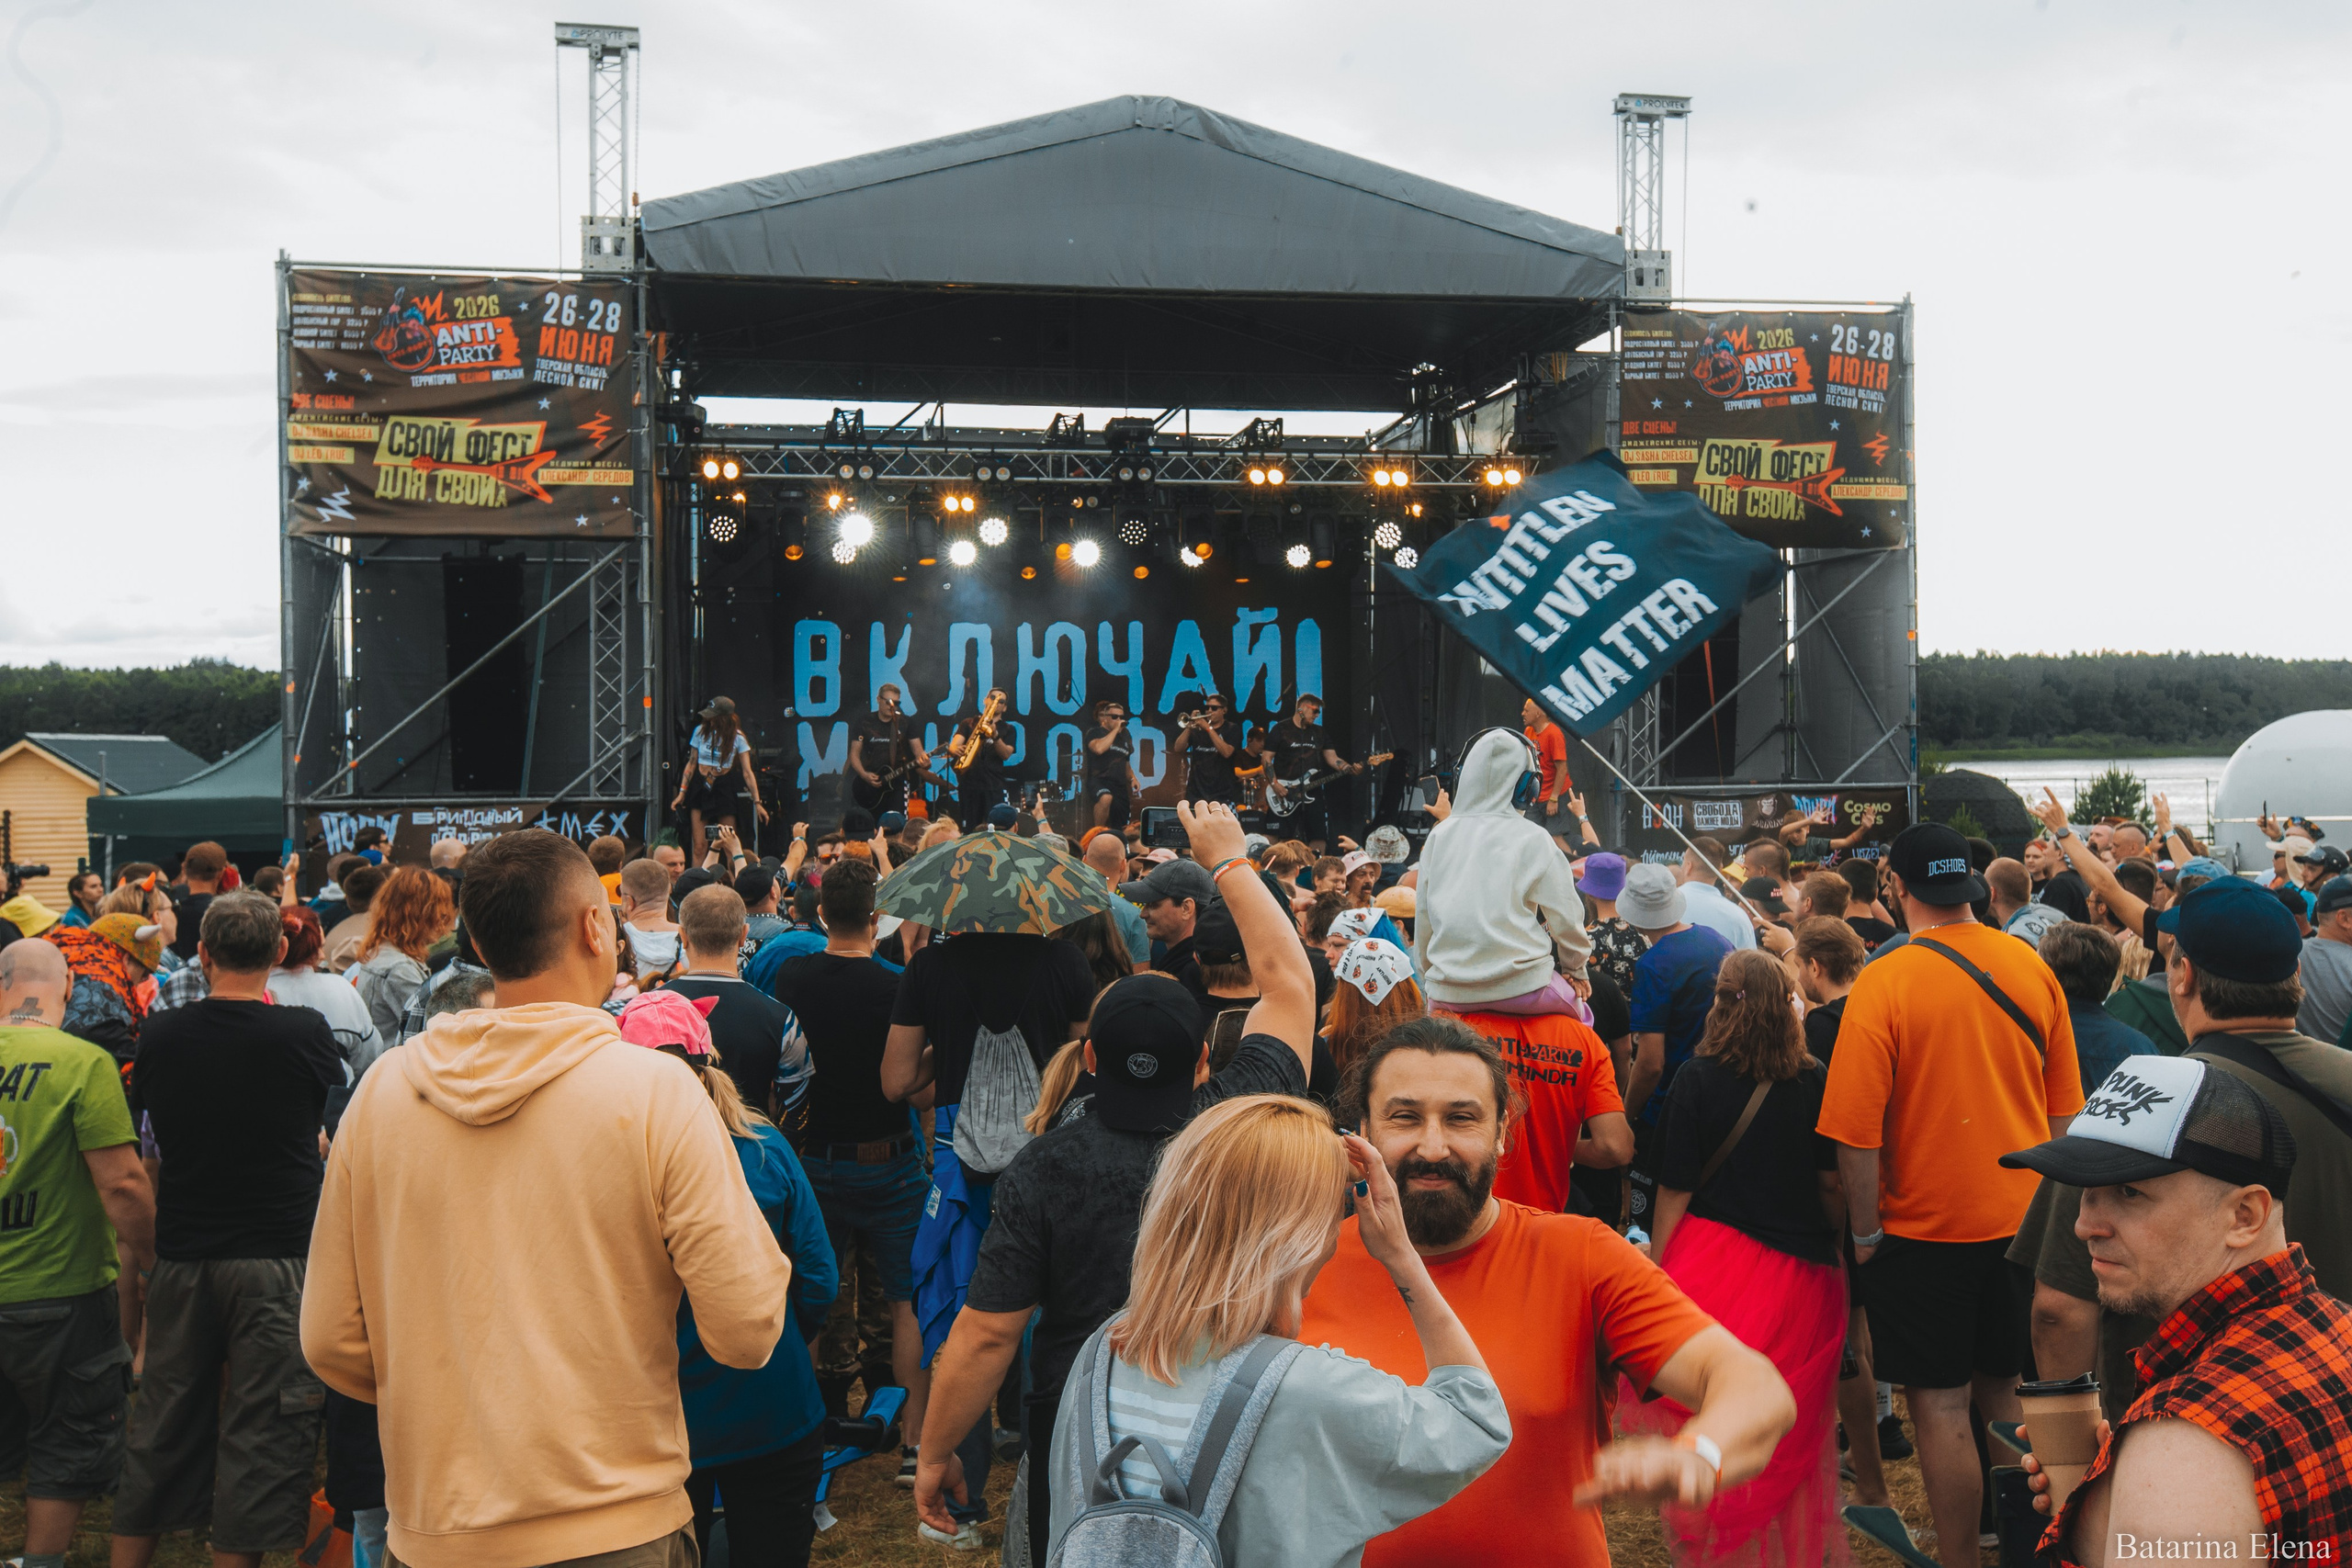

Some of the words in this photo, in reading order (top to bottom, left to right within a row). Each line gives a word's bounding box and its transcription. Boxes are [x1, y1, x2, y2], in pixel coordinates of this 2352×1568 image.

[1643, 98, 1680, 108] PROLYTE
[454, 294, 501, 320] 2026
[542, 291, 622, 333] 26-28
[436, 321, 503, 347] ANTI-
[1757, 328, 1795, 350] 2026
[1830, 324, 1895, 361] 26-28
[438, 344, 496, 367] PARTY
[538, 325, 615, 366] ИЮНЯ
[536, 358, 572, 373] ТВЕРСКАЯ
[1745, 352, 1798, 375] ANTI-
[1827, 354, 1889, 391] ИЮНЯ
[410, 373, 458, 388] ТЕРРИТОРИЯ
[491, 367, 525, 381] МУЗЫКИ
[533, 369, 574, 387] ЛЕСНОЙ
[578, 376, 606, 391] СКИТ
[1746, 371, 1792, 391] PARTY
[1826, 383, 1856, 397] ТВЕРСКАЯ
[1724, 398, 1762, 412] ТЕРРИТОРИЯ
[1790, 392, 1817, 405] МУЗЫКИ
[1825, 394, 1858, 410] ЛЕСНОЙ
[1861, 400, 1883, 413] СКИТ
[292, 425, 304, 437] DJ
[335, 427, 373, 440] CHELSEA
[1623, 421, 1641, 435] ДВЕ
[1643, 421, 1677, 434] СЦЕНЫ!
[388, 421, 457, 461] СВОЙ
[466, 429, 533, 465] ФЕСТ
[294, 447, 305, 460] DJ
[307, 448, 322, 460] LEO
[325, 449, 346, 461] TRUE
[1623, 450, 1634, 462] DJ
[1635, 450, 1660, 461] SASHA
[1661, 450, 1693, 461] CHELSEA
[1705, 443, 1762, 479] СВОЙ
[1770, 449, 1826, 480] ФЕСТ
[375, 465, 428, 502] ДЛЯ
[540, 470, 590, 483] АЛЕКСАНДР
[593, 470, 633, 484] СЕРЕДОВ!
[1637, 470, 1650, 482] LEO
[1653, 470, 1671, 482] TRUE
[1832, 485, 1872, 497] АЛЕКСАНДР
[1514, 540, 1637, 653] LIVES
[1540, 578, 1719, 722] MATTER
[1696, 803, 1739, 817] СВОБОДА
[1697, 816, 1719, 827] ВАЖНЕЕ
[1720, 816, 1739, 826] МОДЫ
[1928, 858, 1966, 876] DCSHOES
